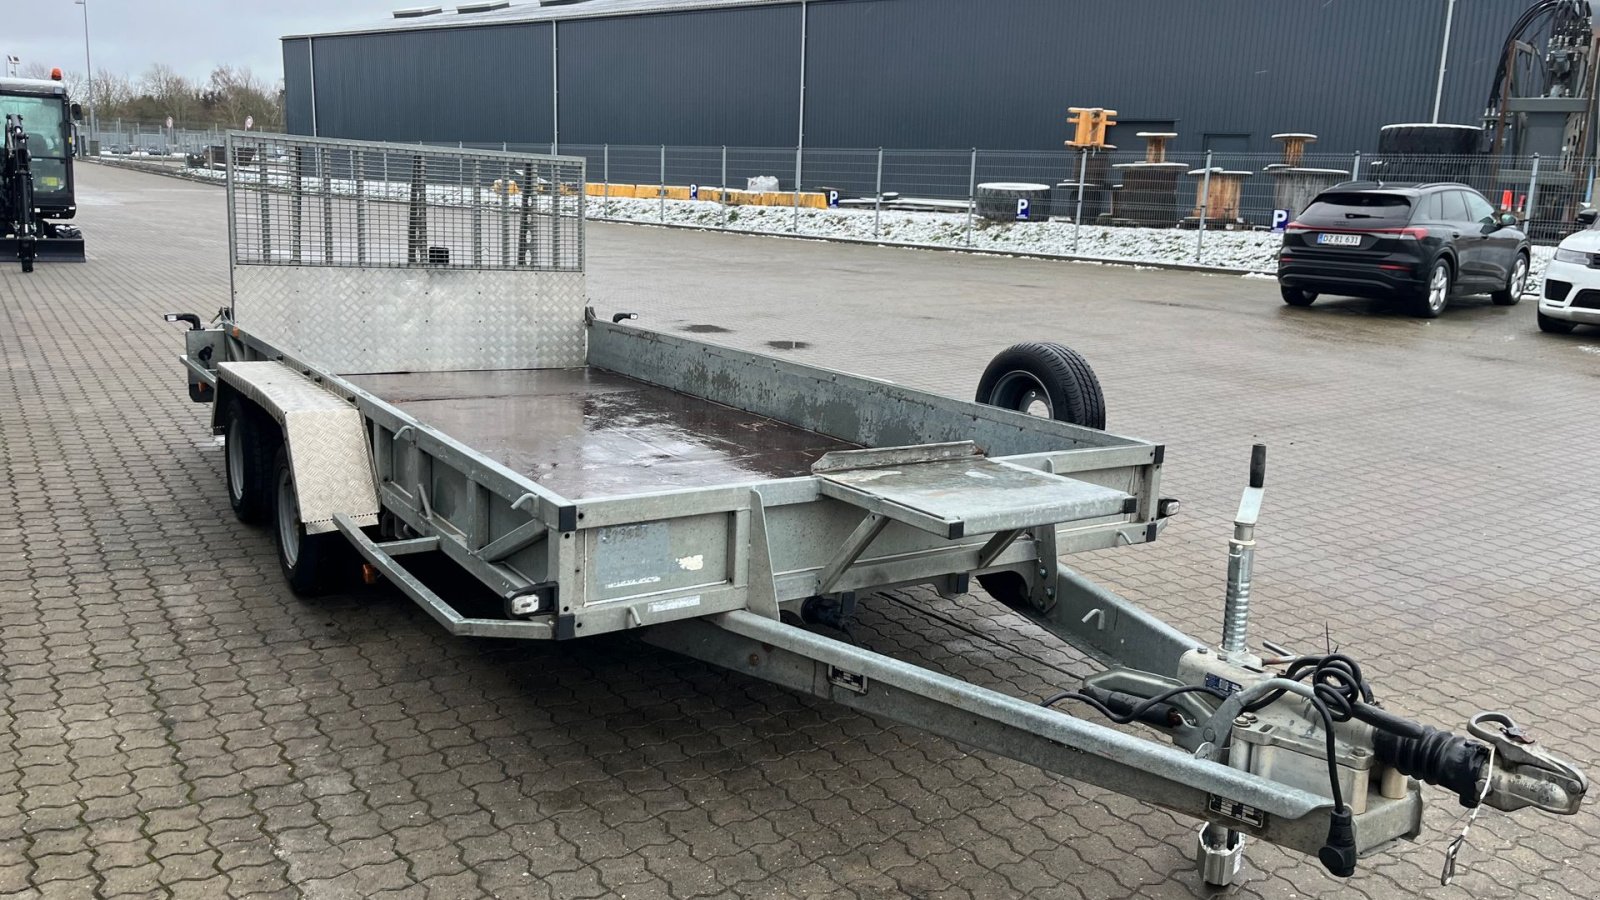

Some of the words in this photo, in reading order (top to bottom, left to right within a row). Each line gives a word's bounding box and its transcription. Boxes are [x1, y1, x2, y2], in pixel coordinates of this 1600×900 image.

[690, 184, 697, 197] P
[830, 190, 838, 204] P
[1017, 199, 1028, 214] P
[1272, 209, 1287, 227] P
[1323, 235, 1334, 243] DZ
[1345, 236, 1359, 244] 631
